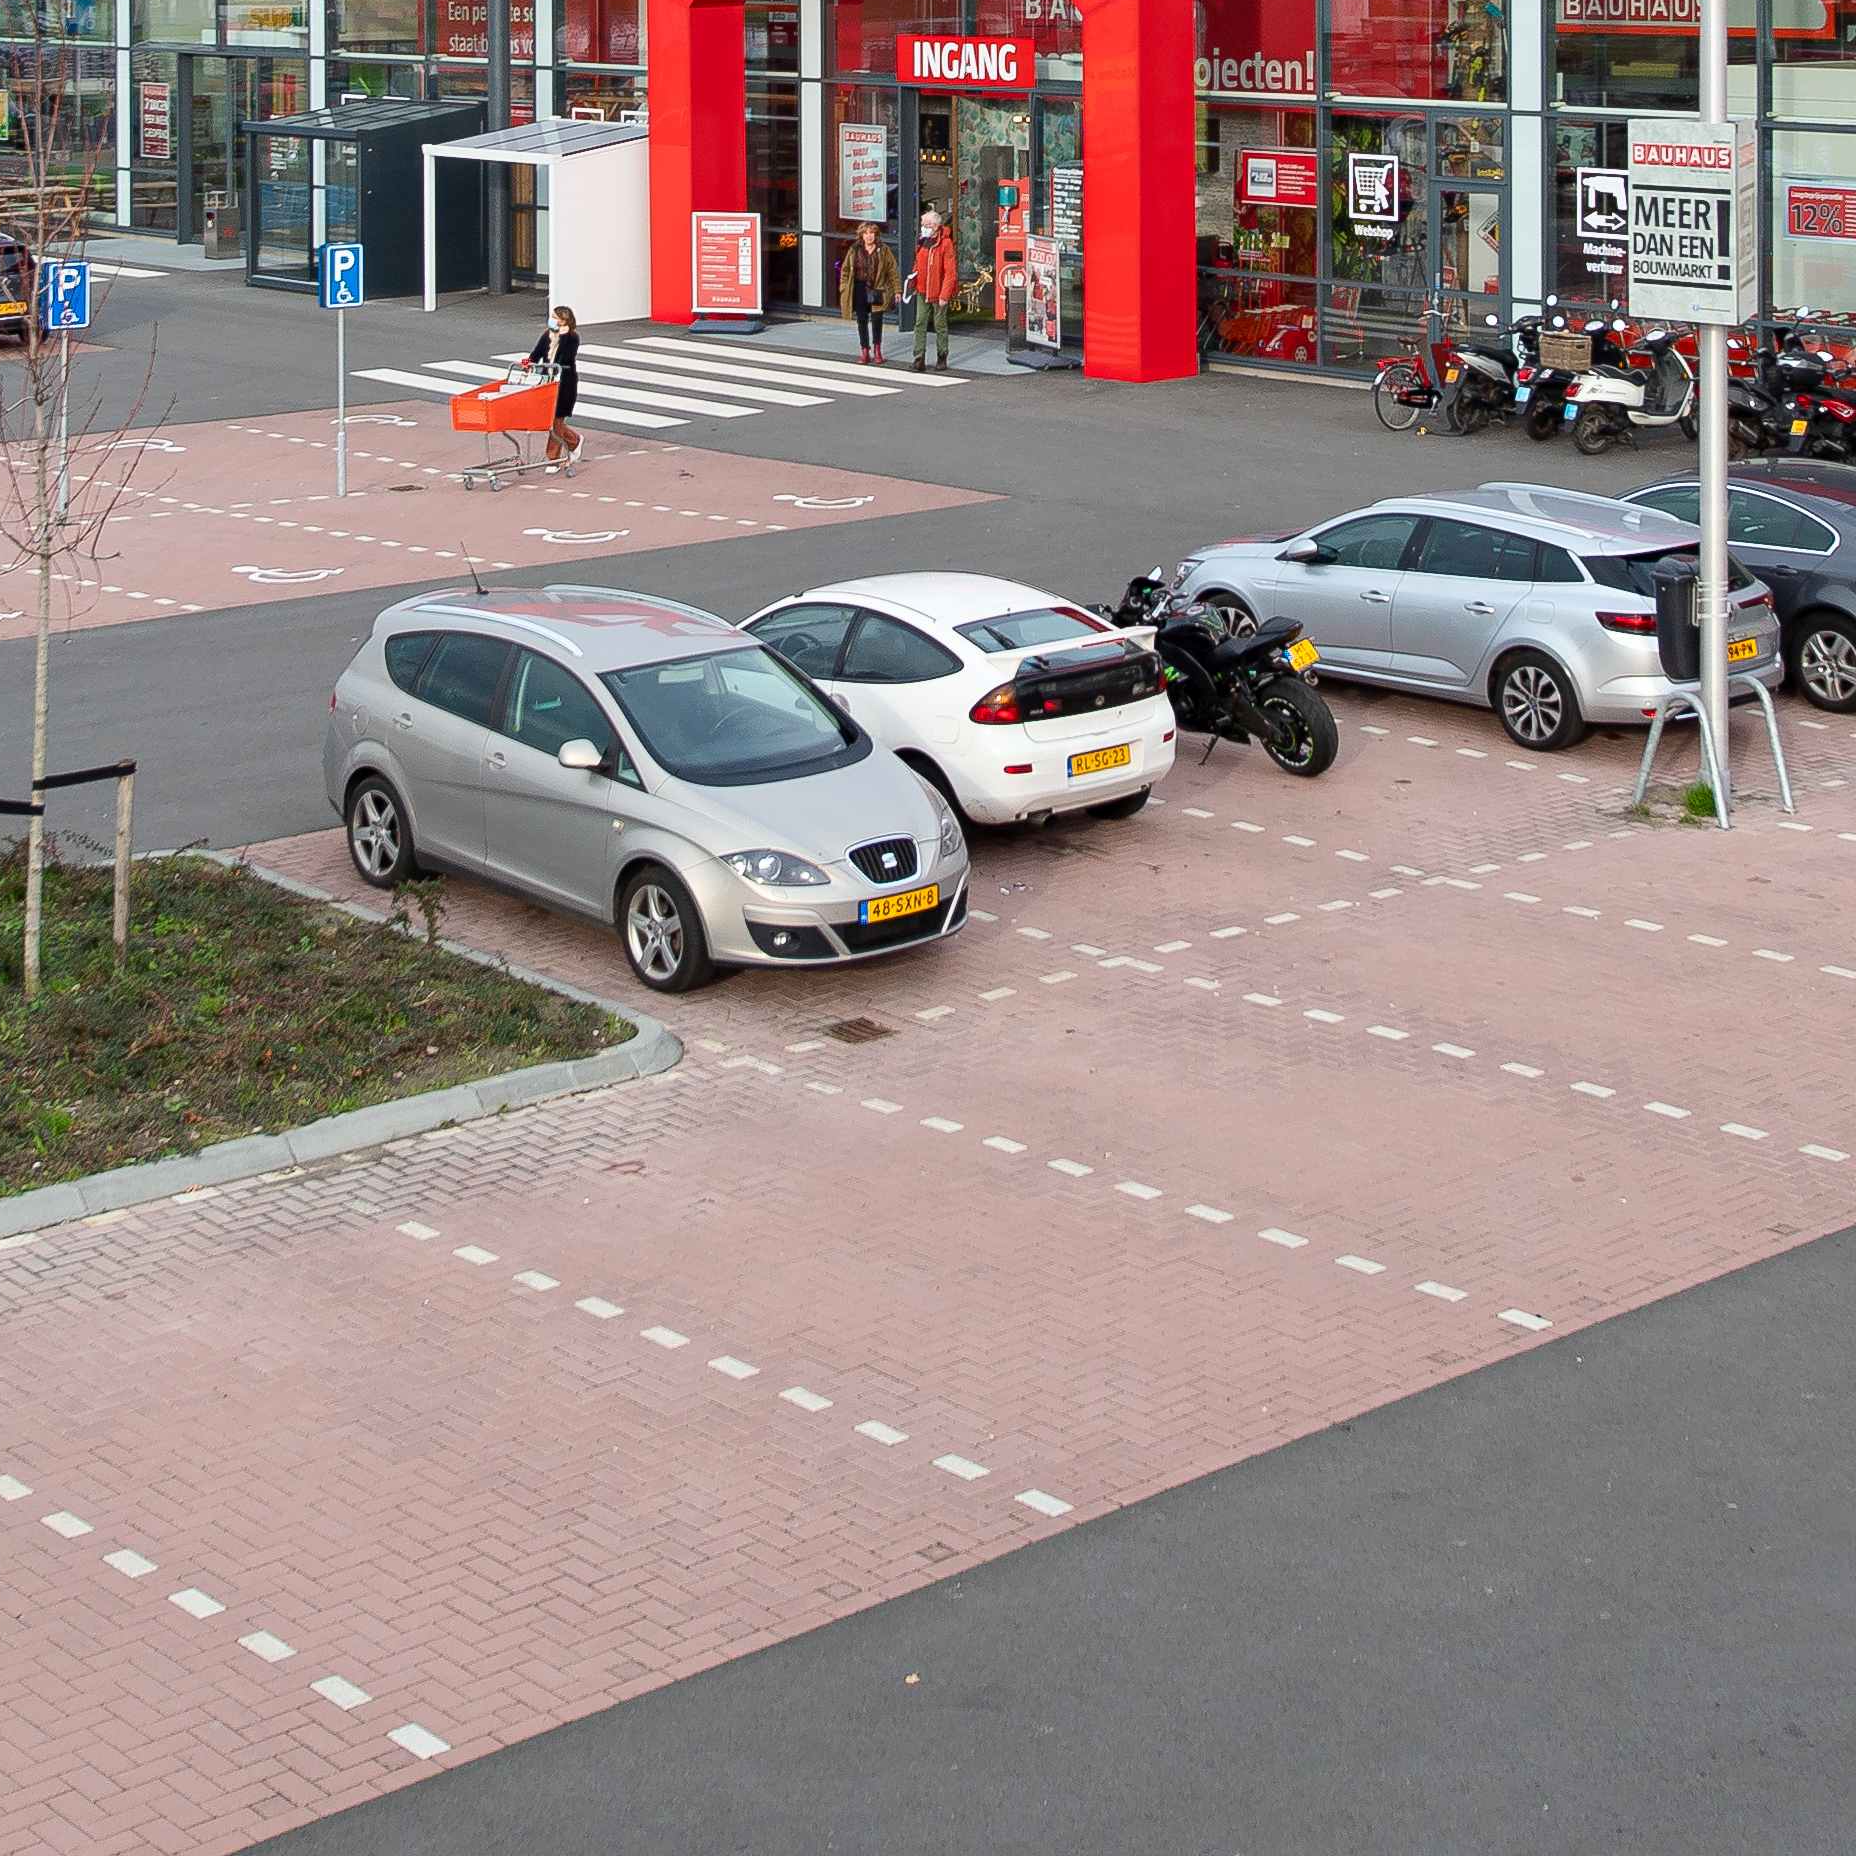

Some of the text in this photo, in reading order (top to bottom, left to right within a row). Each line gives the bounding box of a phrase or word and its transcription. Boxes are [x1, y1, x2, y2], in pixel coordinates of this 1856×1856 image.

[448, 1, 470, 21] Een
[449, 32, 479, 53] staat
[913, 41, 1017, 81] INGANG
[1634, 145, 1730, 167] BAUHAUS
[1634, 195, 1711, 231] MEER
[1791, 203, 1842, 234] 12%
[1354, 224, 1394, 240] Webshop
[1633, 232, 1714, 260] DAN EEN
[334, 249, 355, 282] P
[1633, 260, 1713, 279] BOUWMARKT
[58, 268, 81, 302] P
[1076, 748, 1126, 771] RL-SG-23
[872, 889, 934, 918] 48-SXN-8
